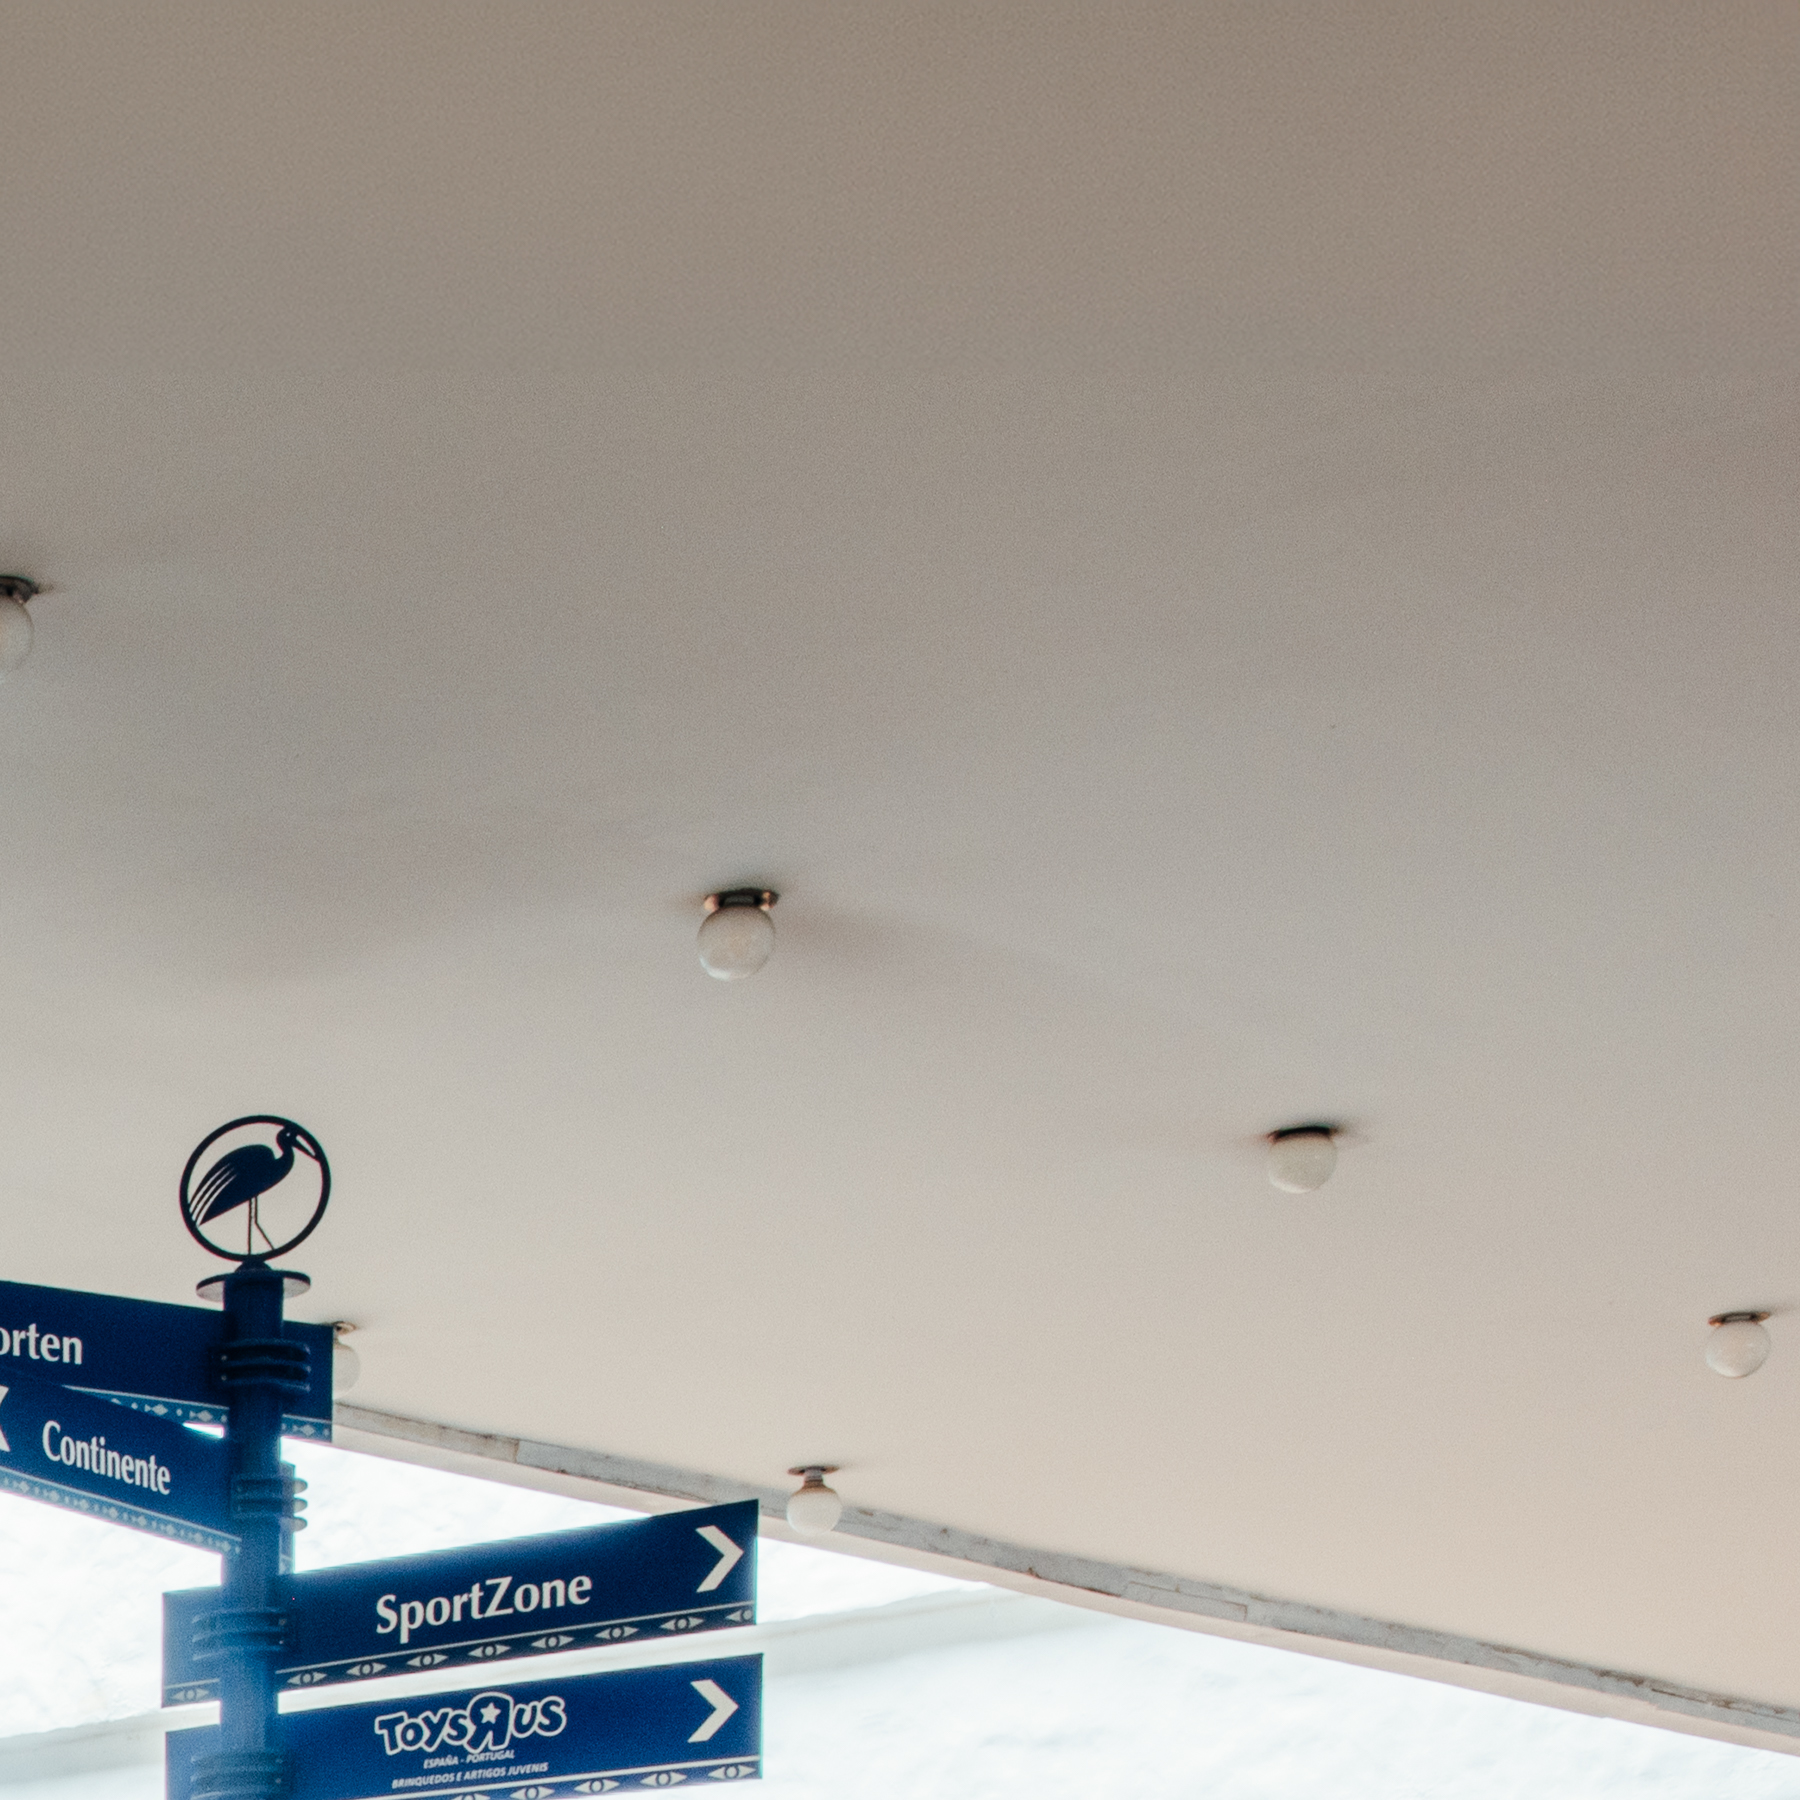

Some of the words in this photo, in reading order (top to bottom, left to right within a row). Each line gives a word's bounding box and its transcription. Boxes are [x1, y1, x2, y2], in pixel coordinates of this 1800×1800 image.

[41, 1419, 171, 1496] Continente
[376, 1575, 593, 1644] SportZone
[392, 1774, 455, 1789] BRINQUEDOS
[456, 1773, 463, 1782] E
[464, 1767, 506, 1781] ARTIGOS
[508, 1762, 549, 1776] JUVENIS
[423, 1755, 459, 1769] ESPAÑA
[466, 1749, 515, 1764] PORTUGAL
